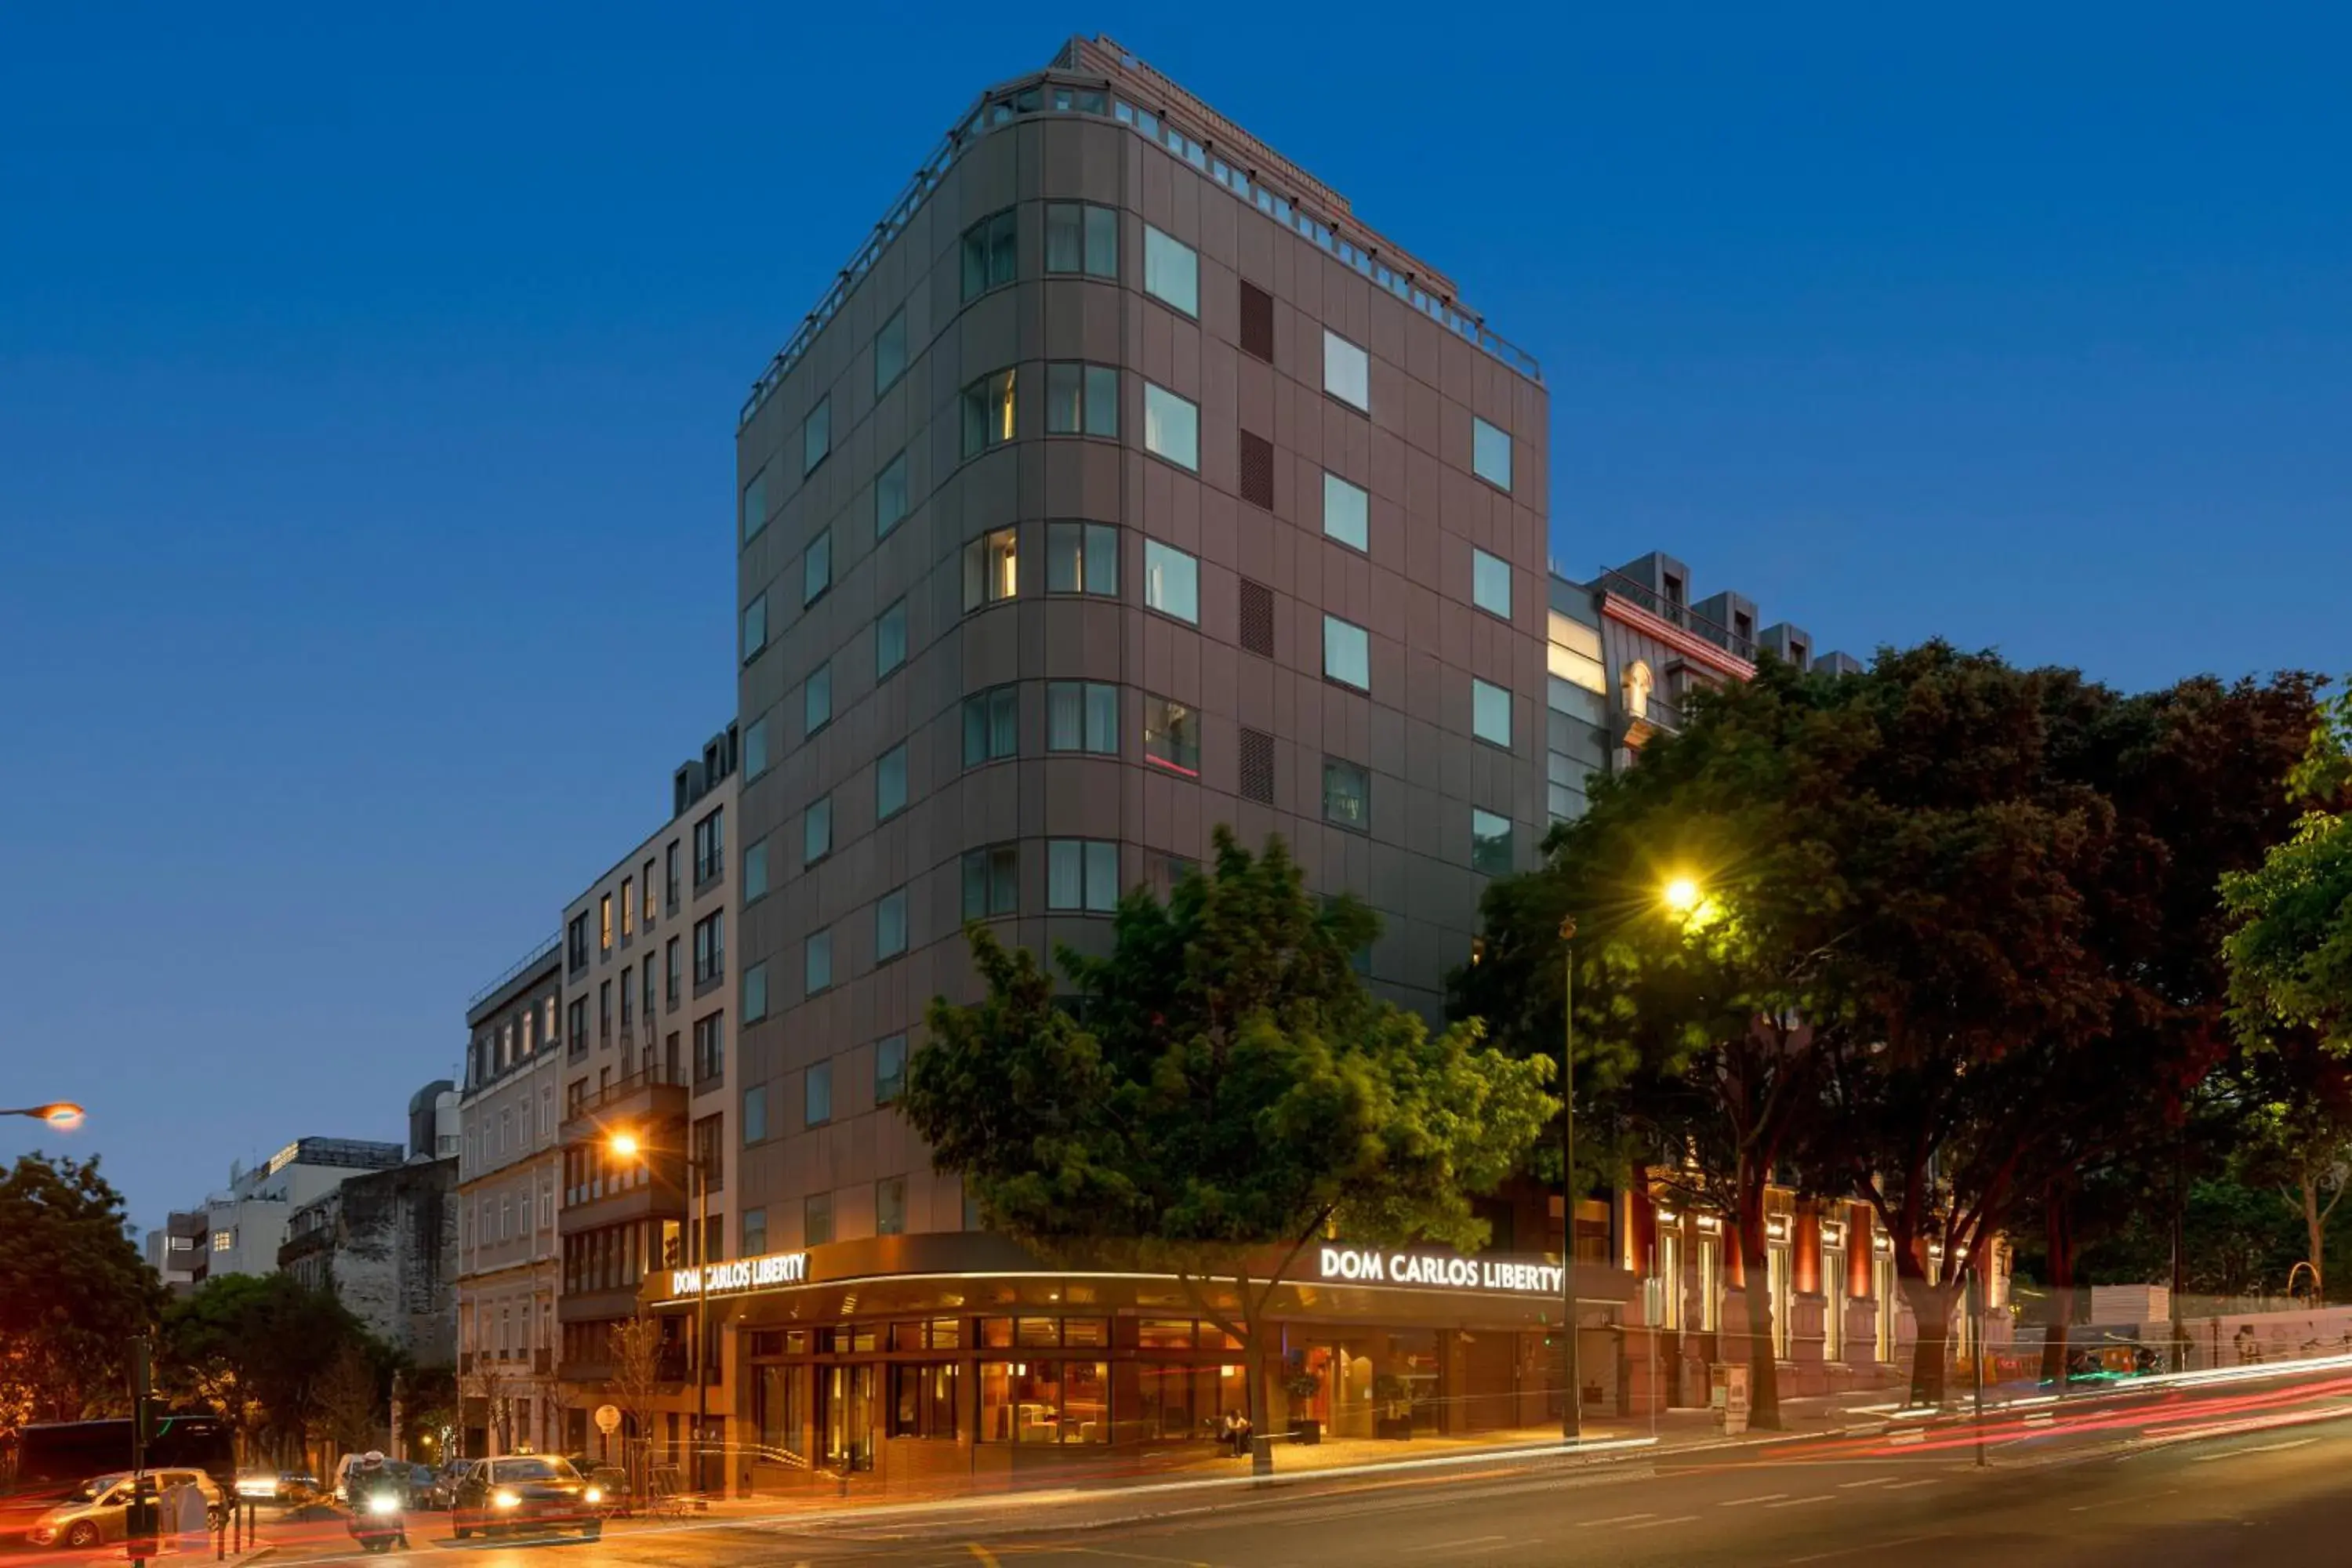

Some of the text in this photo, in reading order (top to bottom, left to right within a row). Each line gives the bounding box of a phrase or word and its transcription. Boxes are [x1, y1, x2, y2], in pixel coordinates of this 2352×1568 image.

[673, 1268, 701, 1294] DOM
[752, 1252, 806, 1284] LIBERTY
[1320, 1248, 1563, 1291] DOM CARLOS LIBERTY
